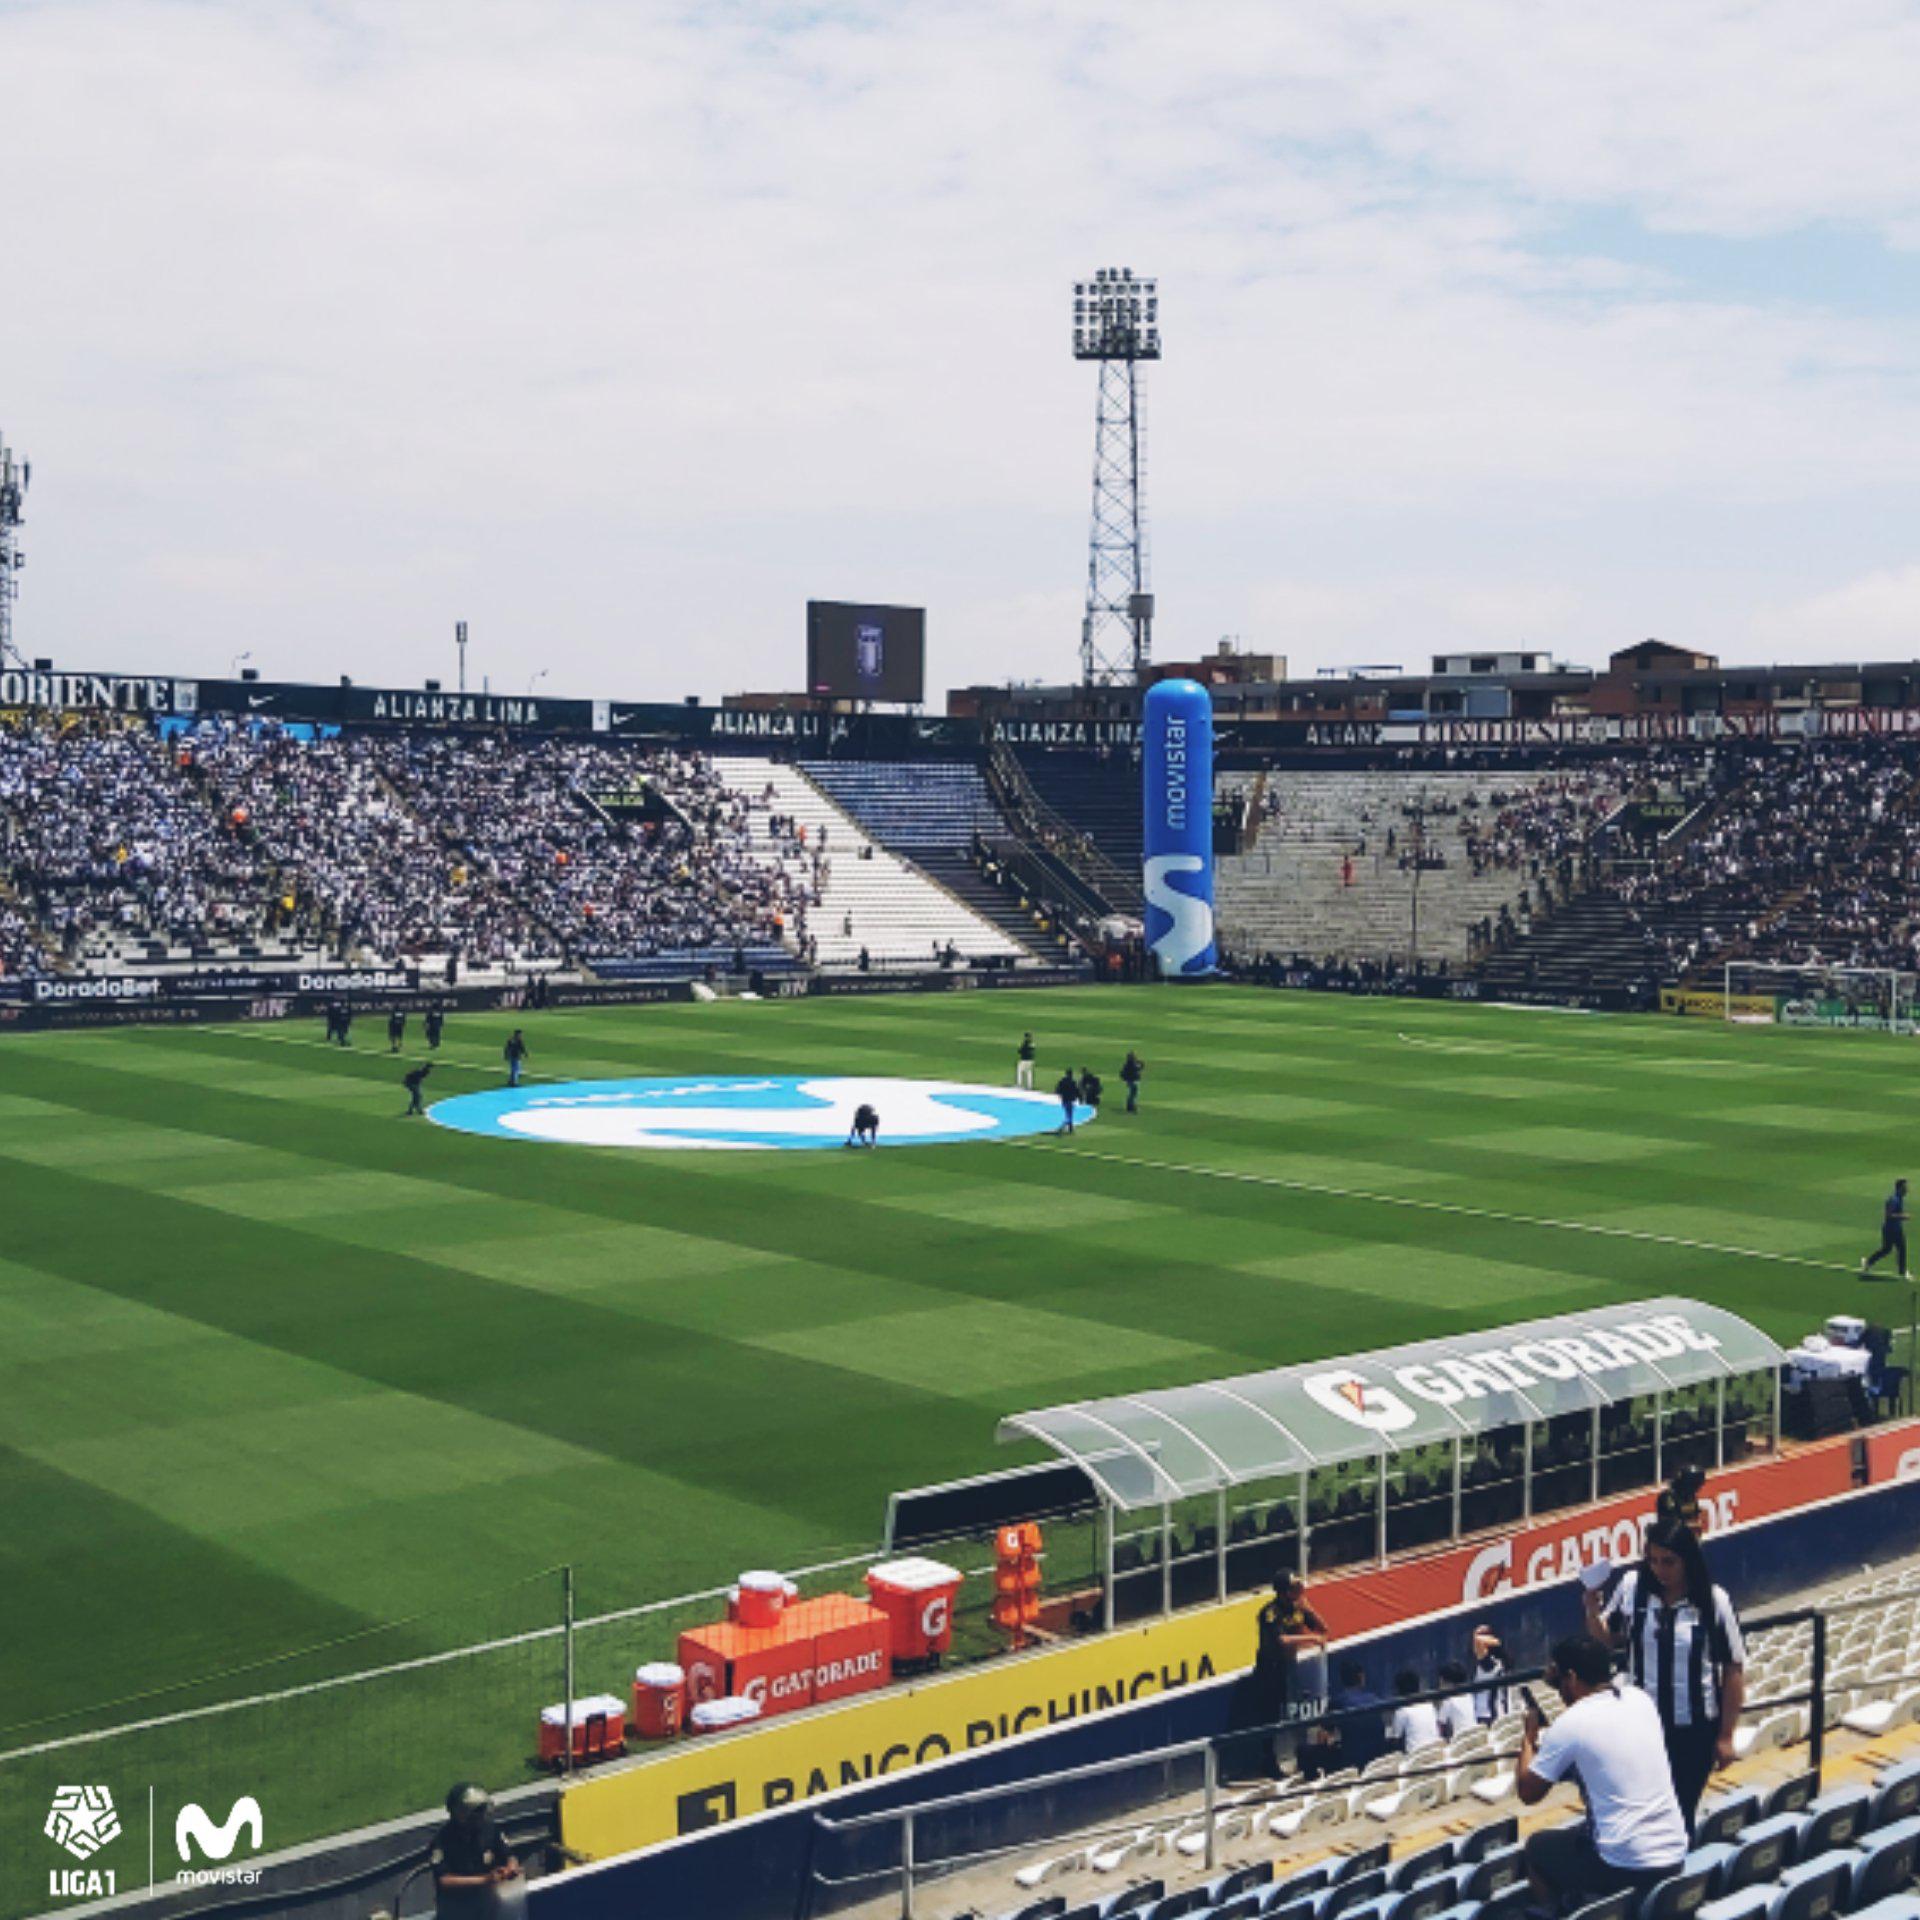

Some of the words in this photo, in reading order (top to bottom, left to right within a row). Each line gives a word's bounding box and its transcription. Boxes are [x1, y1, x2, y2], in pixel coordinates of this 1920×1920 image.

[0, 672, 168, 711] ORIENTE
[374, 693, 476, 721] ALIANZA
[711, 712, 795, 736] ALIANZA
[803, 715, 850, 738] LIA
[993, 722, 1086, 743] ALIANZA
[1164, 715, 1186, 830] movistar
[36, 978, 160, 998] DoradoBet
[299, 971, 407, 990] DoradoBet
[1393, 1314, 1722, 1406] GATORADE
[922, 1597, 947, 1636] G
[771, 1650, 883, 1699] GATORADE
